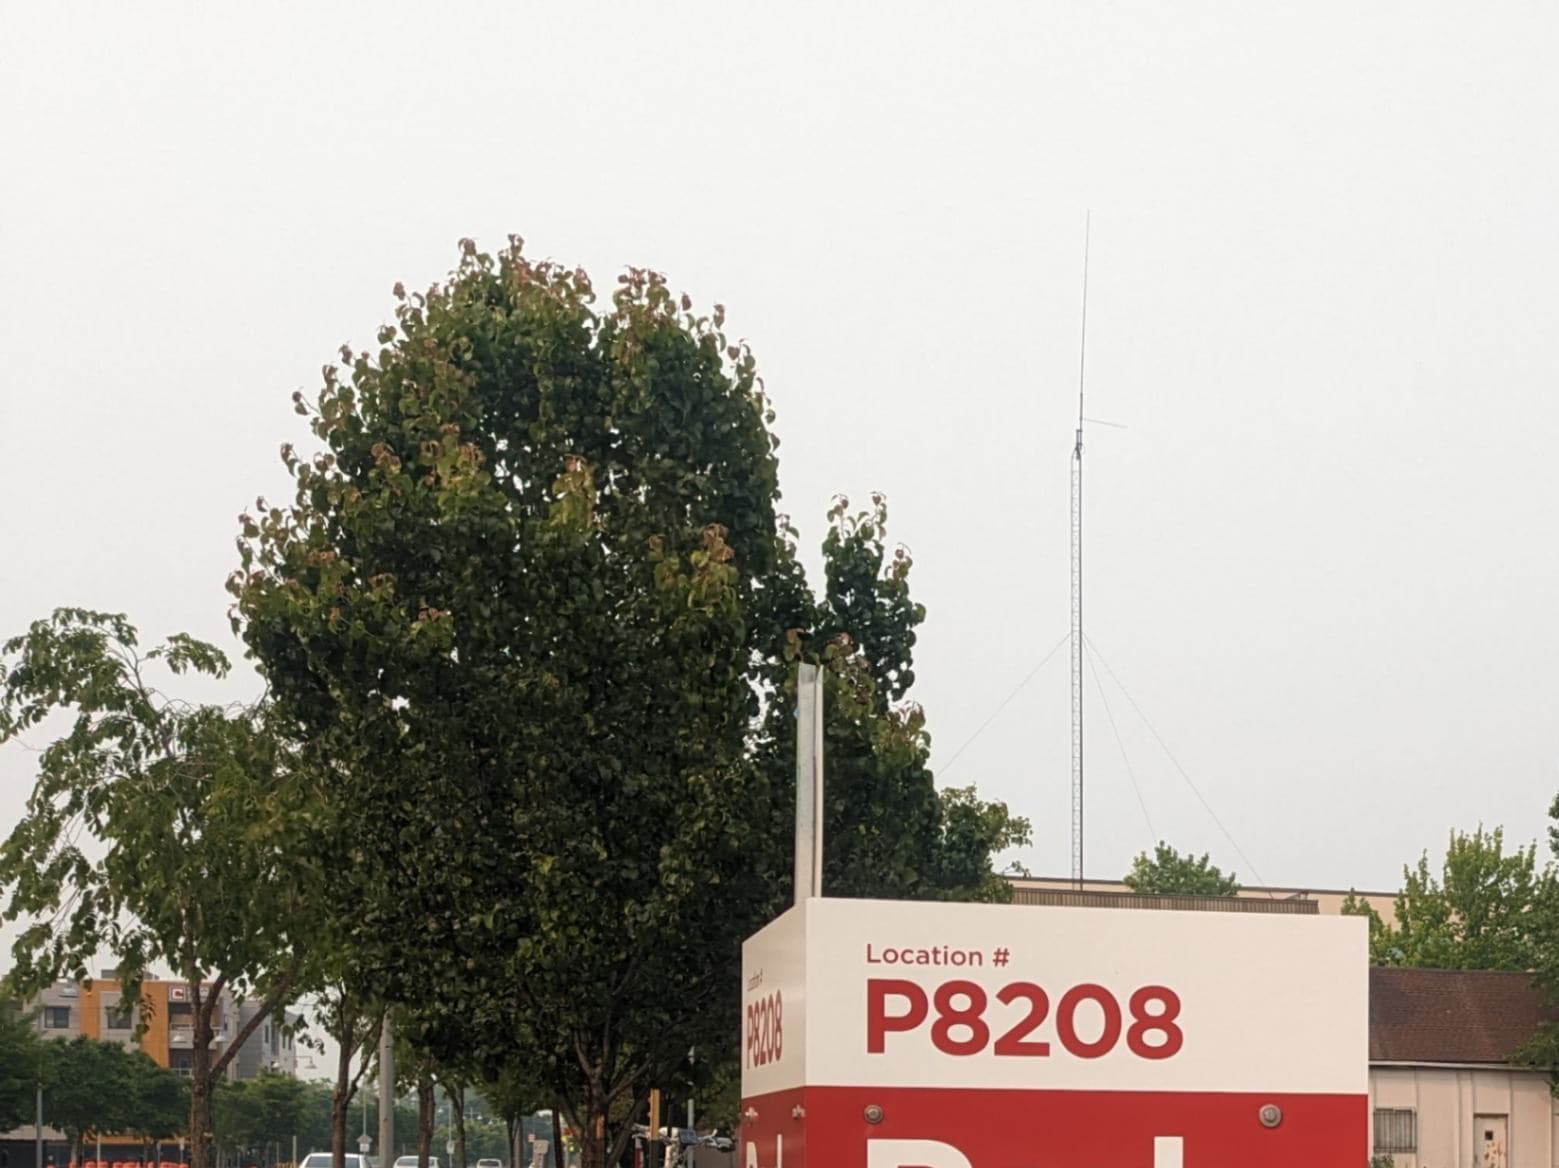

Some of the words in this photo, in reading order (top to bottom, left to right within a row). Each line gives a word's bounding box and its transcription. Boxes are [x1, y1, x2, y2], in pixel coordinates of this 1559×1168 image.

[866, 943, 983, 967] Location
[992, 947, 1010, 967] #
[746, 989, 783, 1070] P8208
[867, 979, 1184, 1060] P8208
